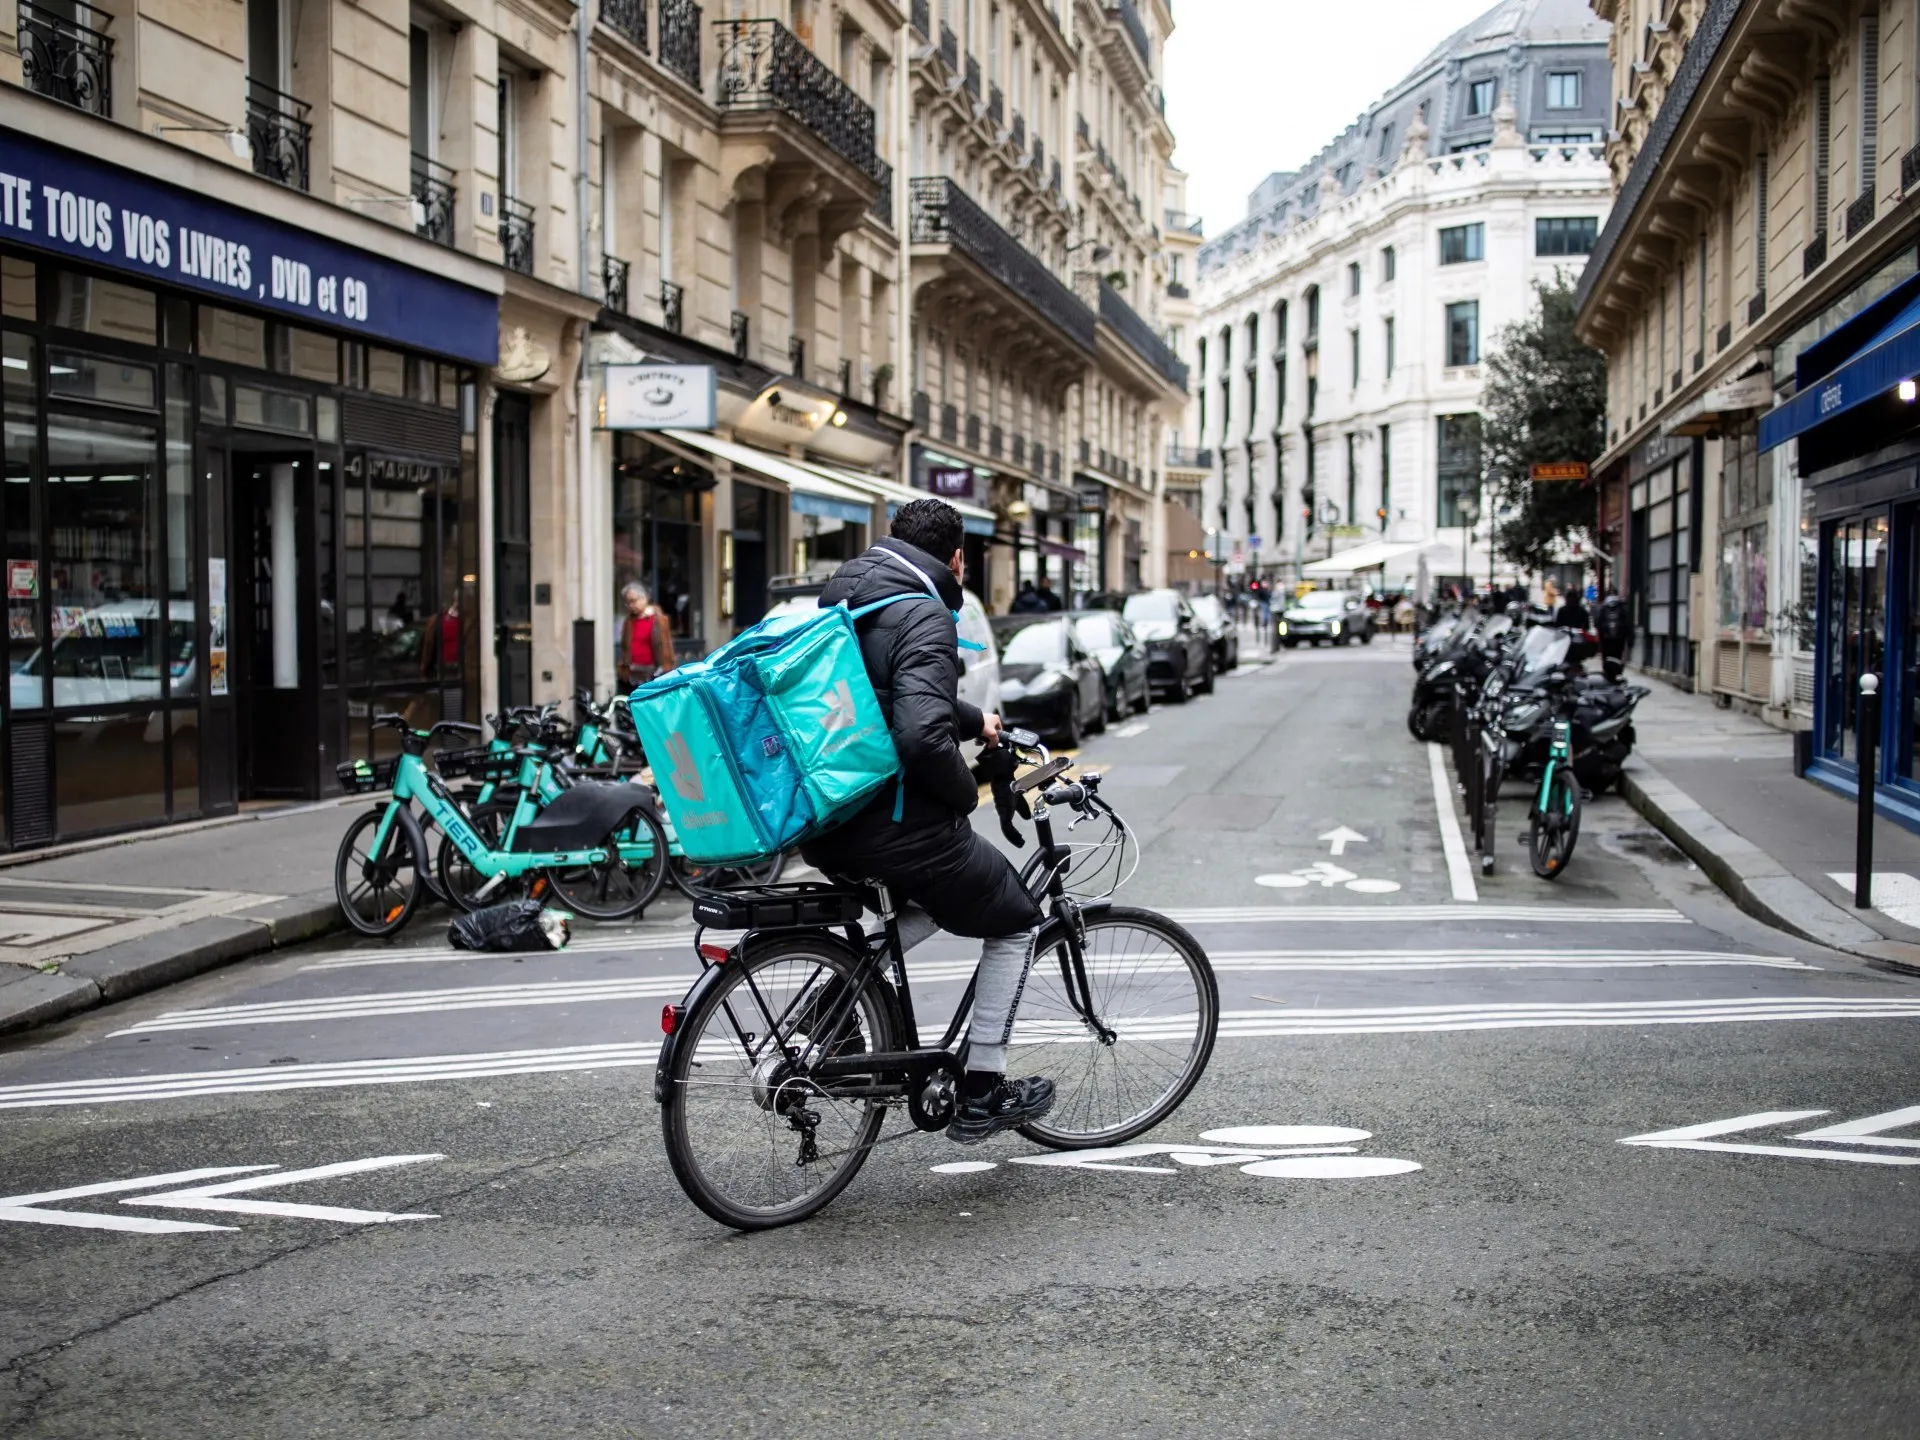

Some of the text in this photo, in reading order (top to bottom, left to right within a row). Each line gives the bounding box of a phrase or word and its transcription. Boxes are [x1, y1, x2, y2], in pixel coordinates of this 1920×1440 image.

[0, 172, 32, 231] TE
[43, 185, 113, 252] TOUS
[122, 209, 170, 269] VOS
[180, 227, 251, 290] LIVRES
[272, 255, 311, 306] DVD
[318, 275, 338, 314] et
[343, 277, 367, 321] CD
[436, 801, 477, 855] TIER
